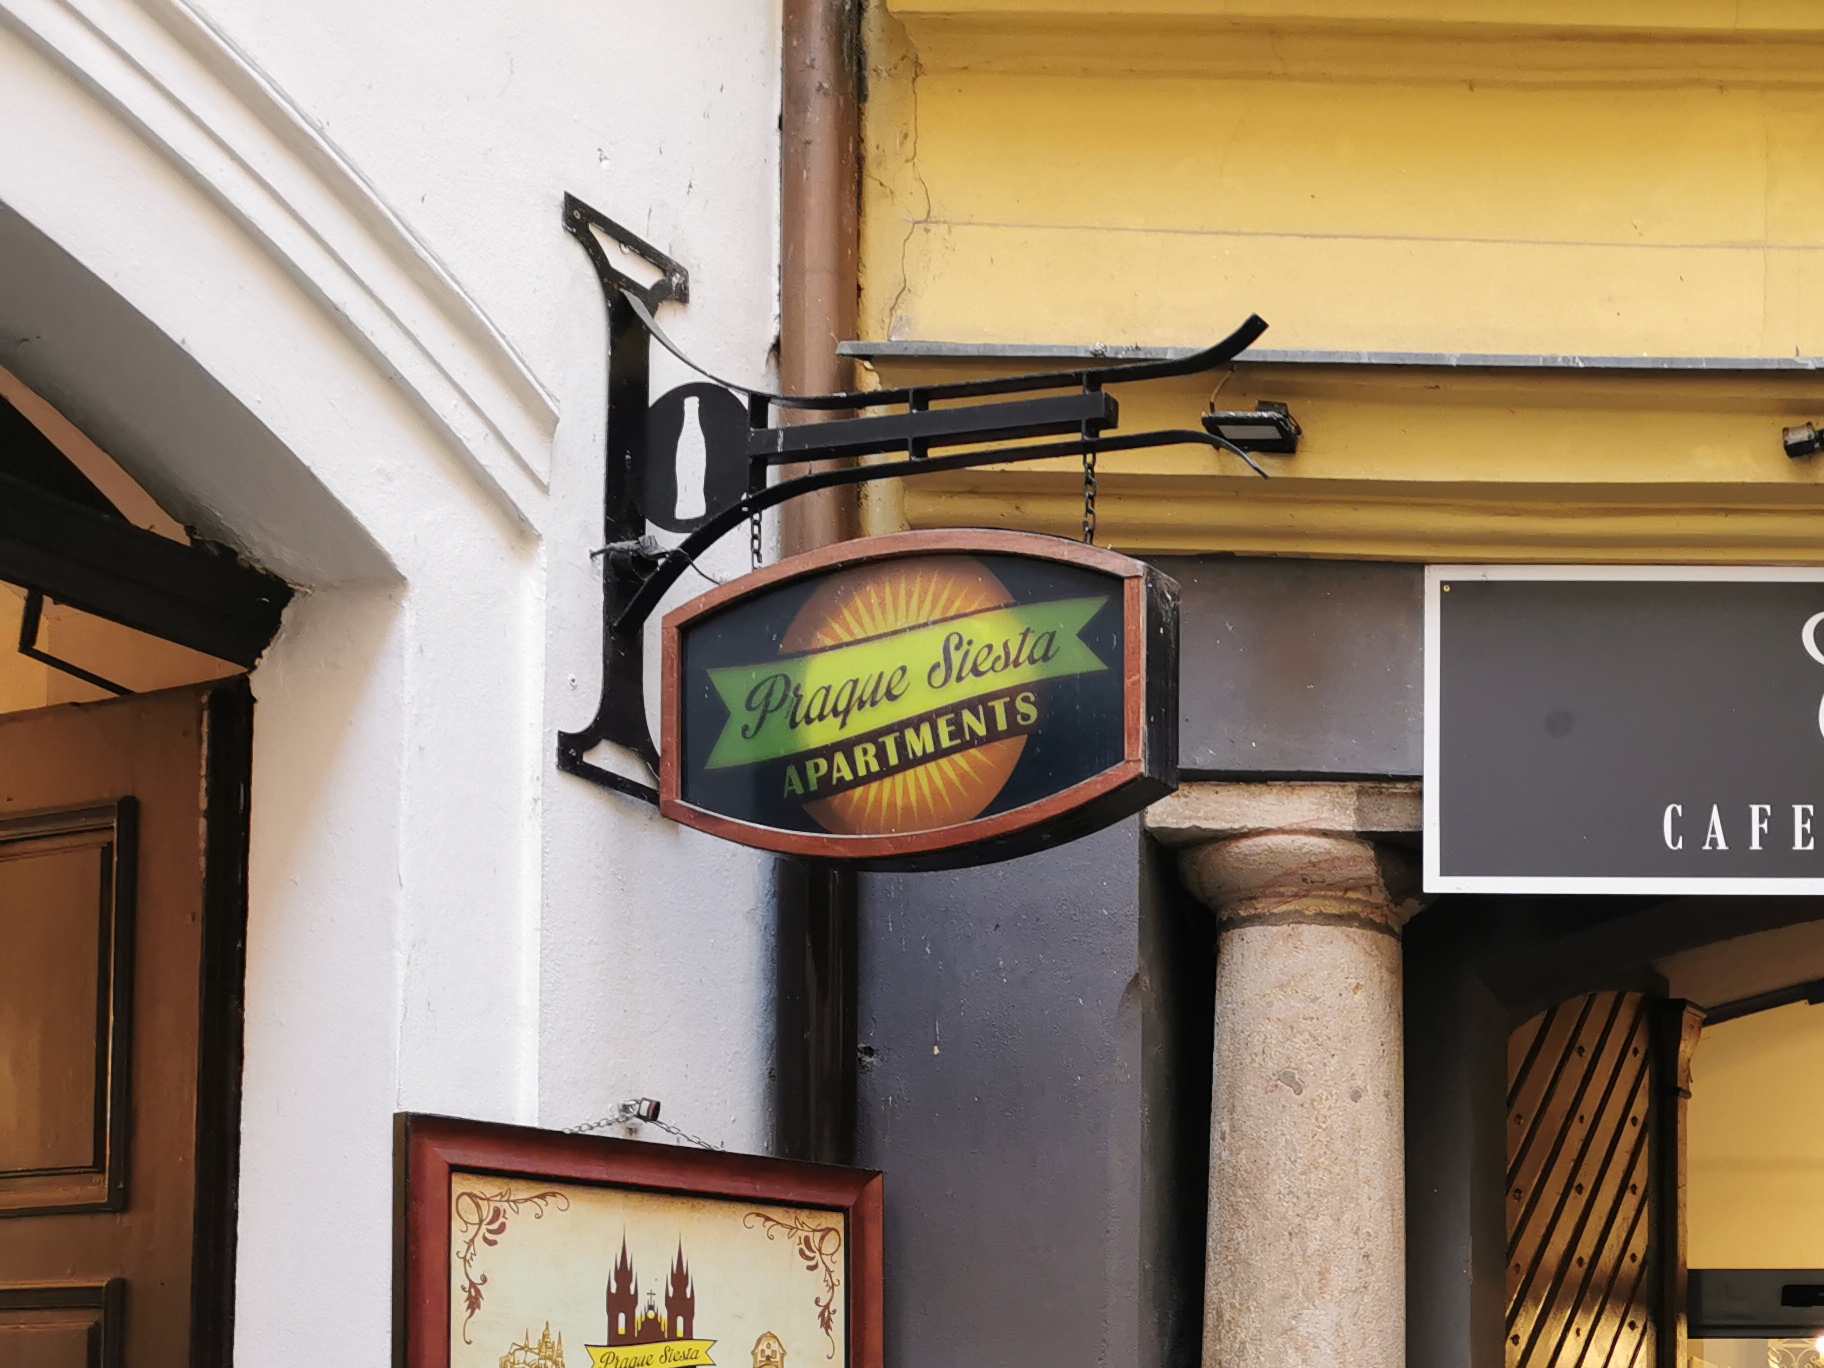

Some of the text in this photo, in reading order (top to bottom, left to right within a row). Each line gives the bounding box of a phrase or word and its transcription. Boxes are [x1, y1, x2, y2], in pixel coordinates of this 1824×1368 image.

[927, 626, 1060, 690] Siesta
[783, 690, 1039, 798] APARTMENTS
[1662, 803, 1815, 851] CAFE
[659, 1346, 700, 1365] Siesta
